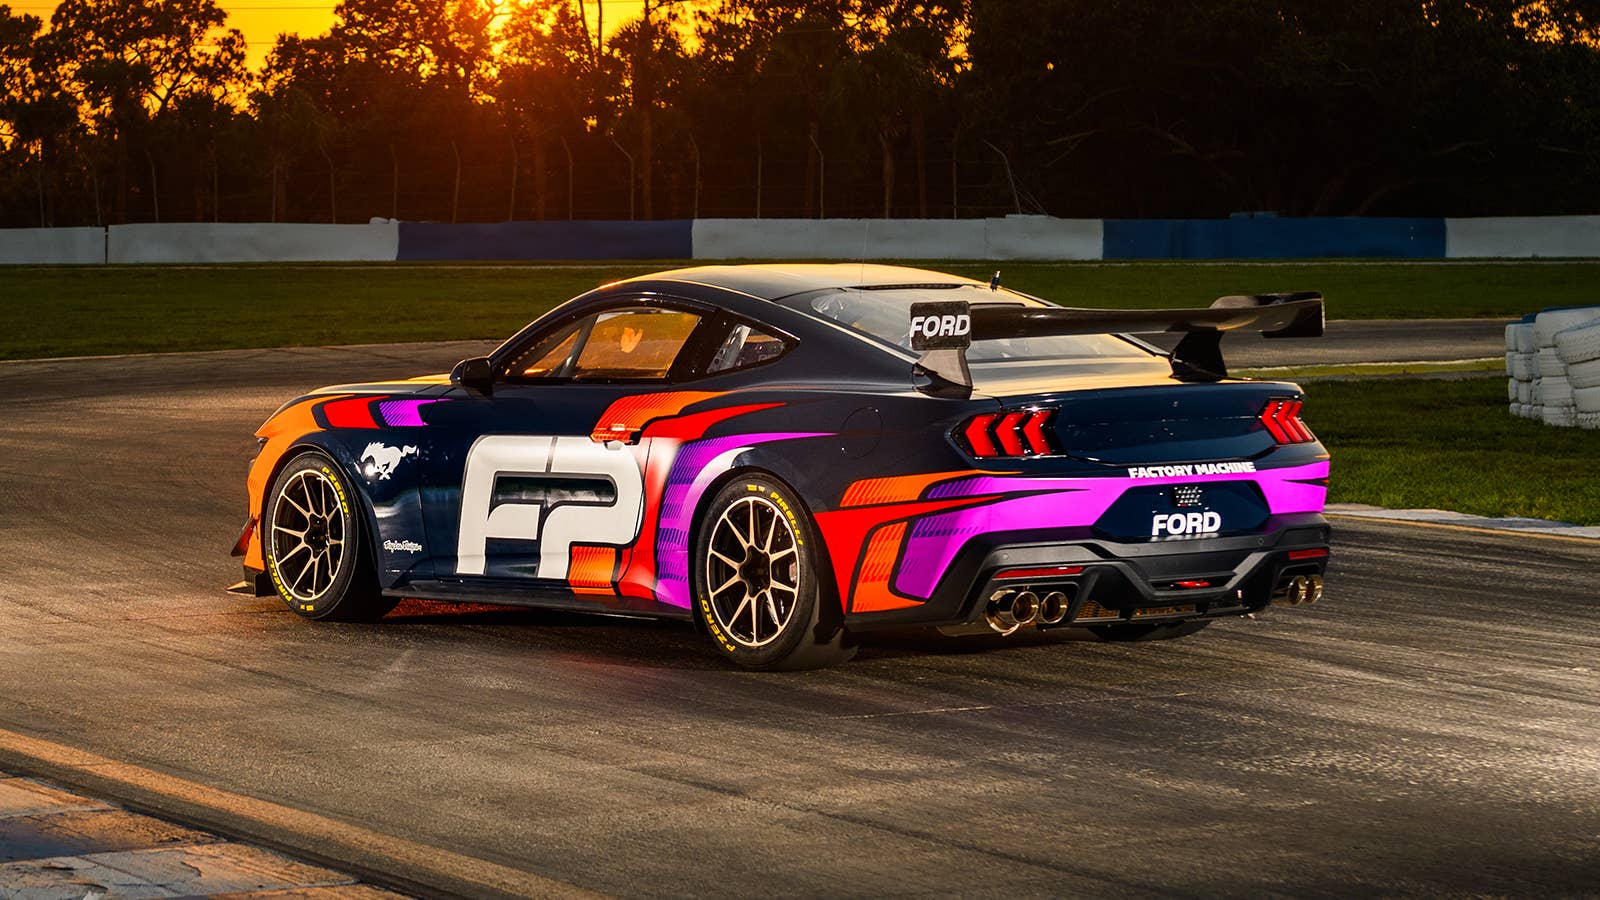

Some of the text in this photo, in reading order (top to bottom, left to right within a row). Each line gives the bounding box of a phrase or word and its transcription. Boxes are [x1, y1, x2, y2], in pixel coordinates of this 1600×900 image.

[909, 314, 971, 338] FORD
[1127, 461, 1257, 479] FACTORY MACHINE
[455, 434, 645, 579] FP
[770, 491, 804, 546] PIRELLI
[1151, 511, 1222, 536] FORD
[268, 554, 293, 602] PIRELLI
